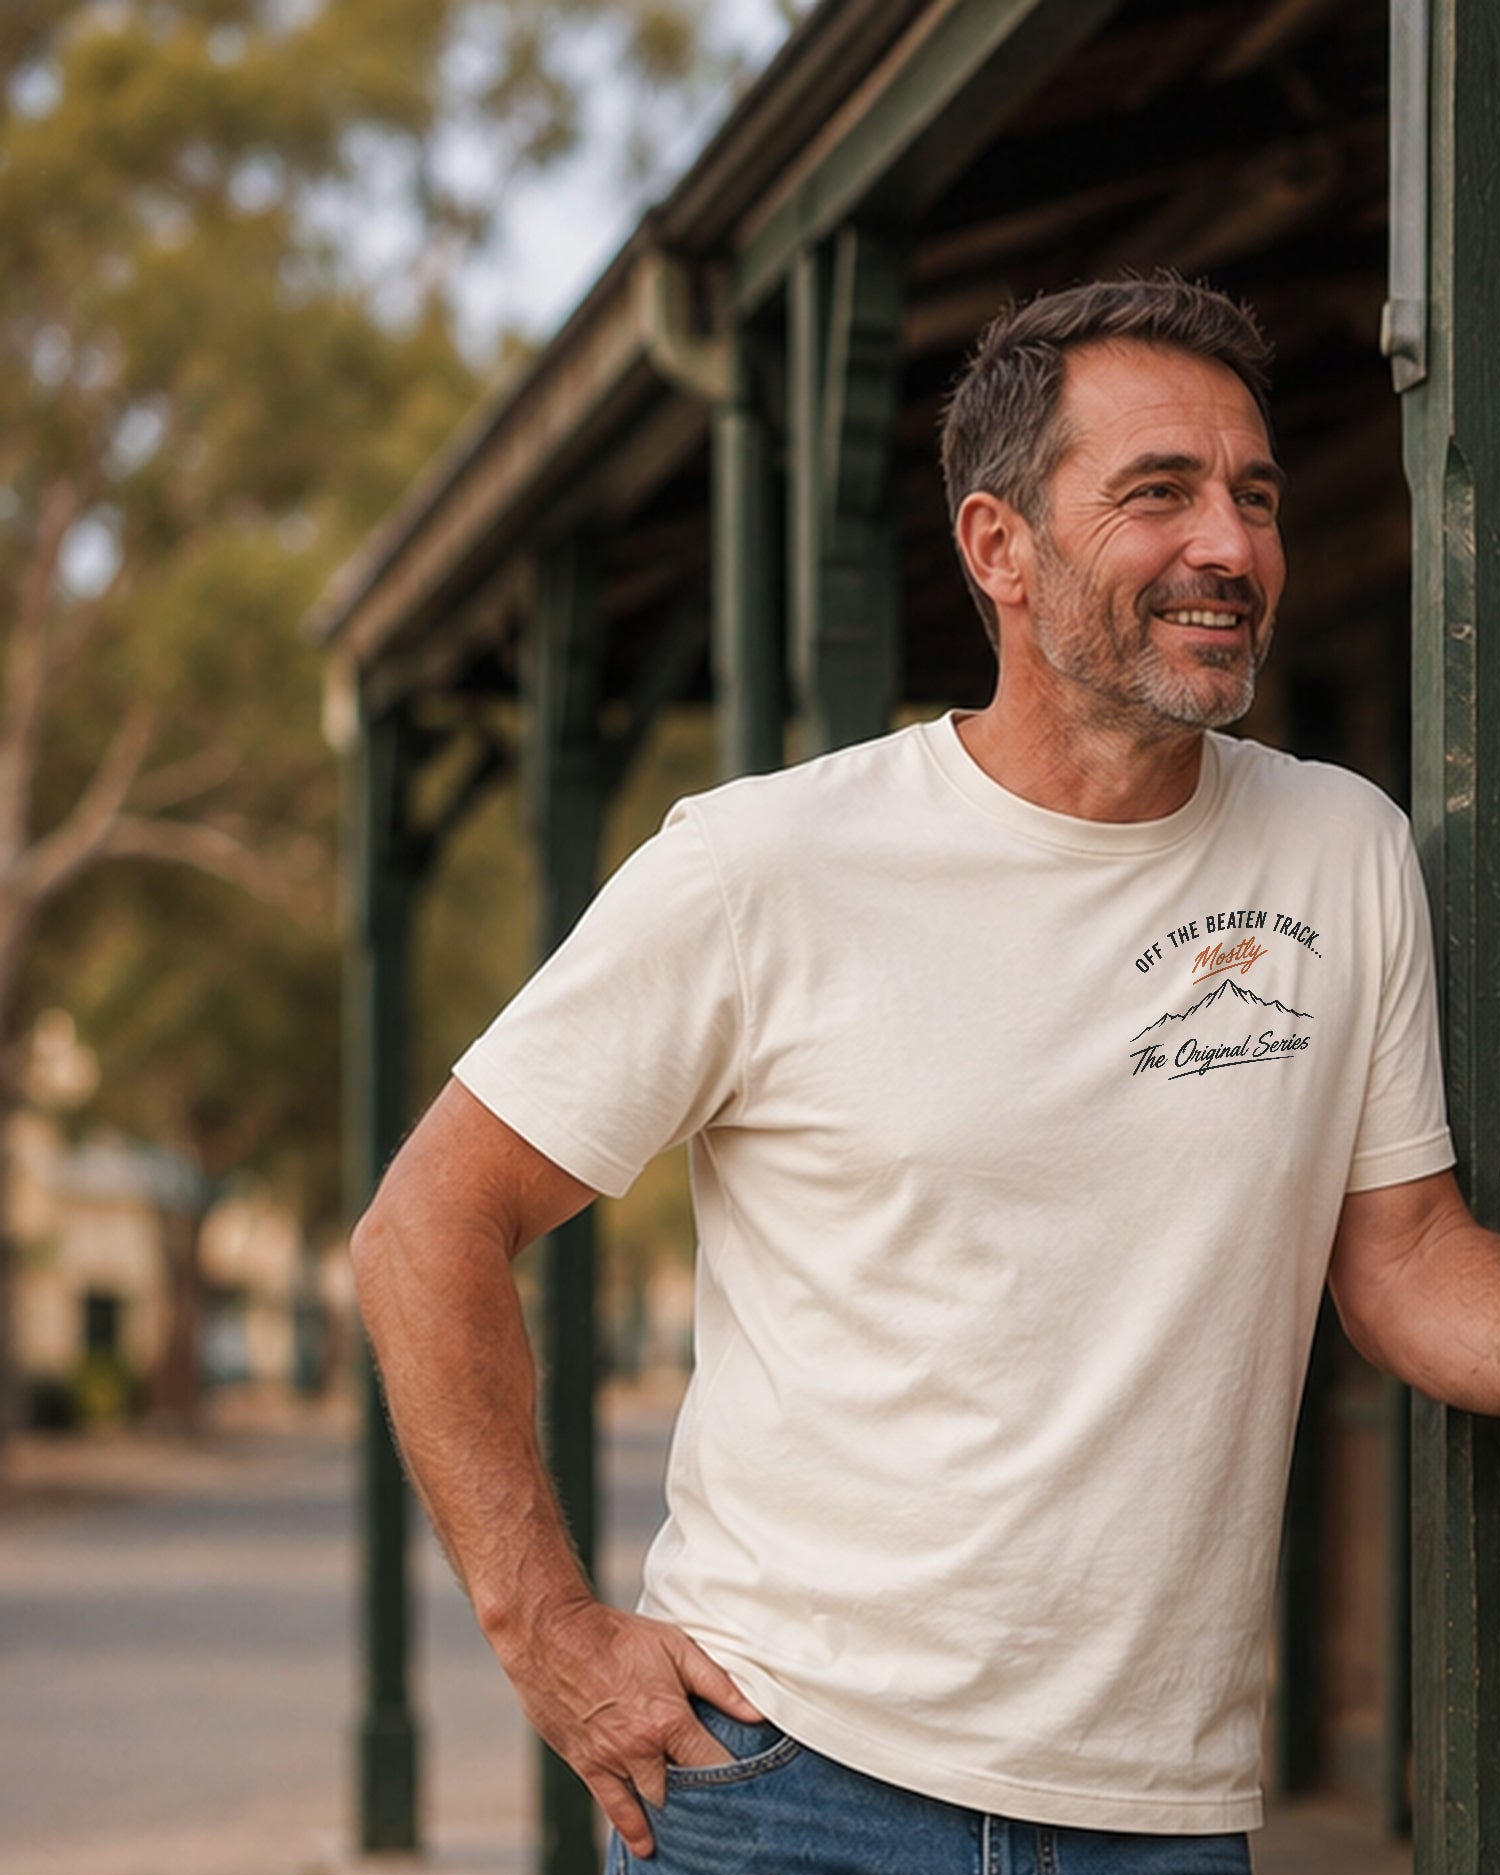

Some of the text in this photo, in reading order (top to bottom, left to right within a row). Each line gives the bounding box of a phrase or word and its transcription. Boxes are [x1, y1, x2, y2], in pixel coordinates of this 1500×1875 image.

[1135, 910, 1322, 974] OFF THE BEATEN TRACK...
[1191, 936, 1268, 977] Mostly
[1130, 1030, 1311, 1076] The Original Series
